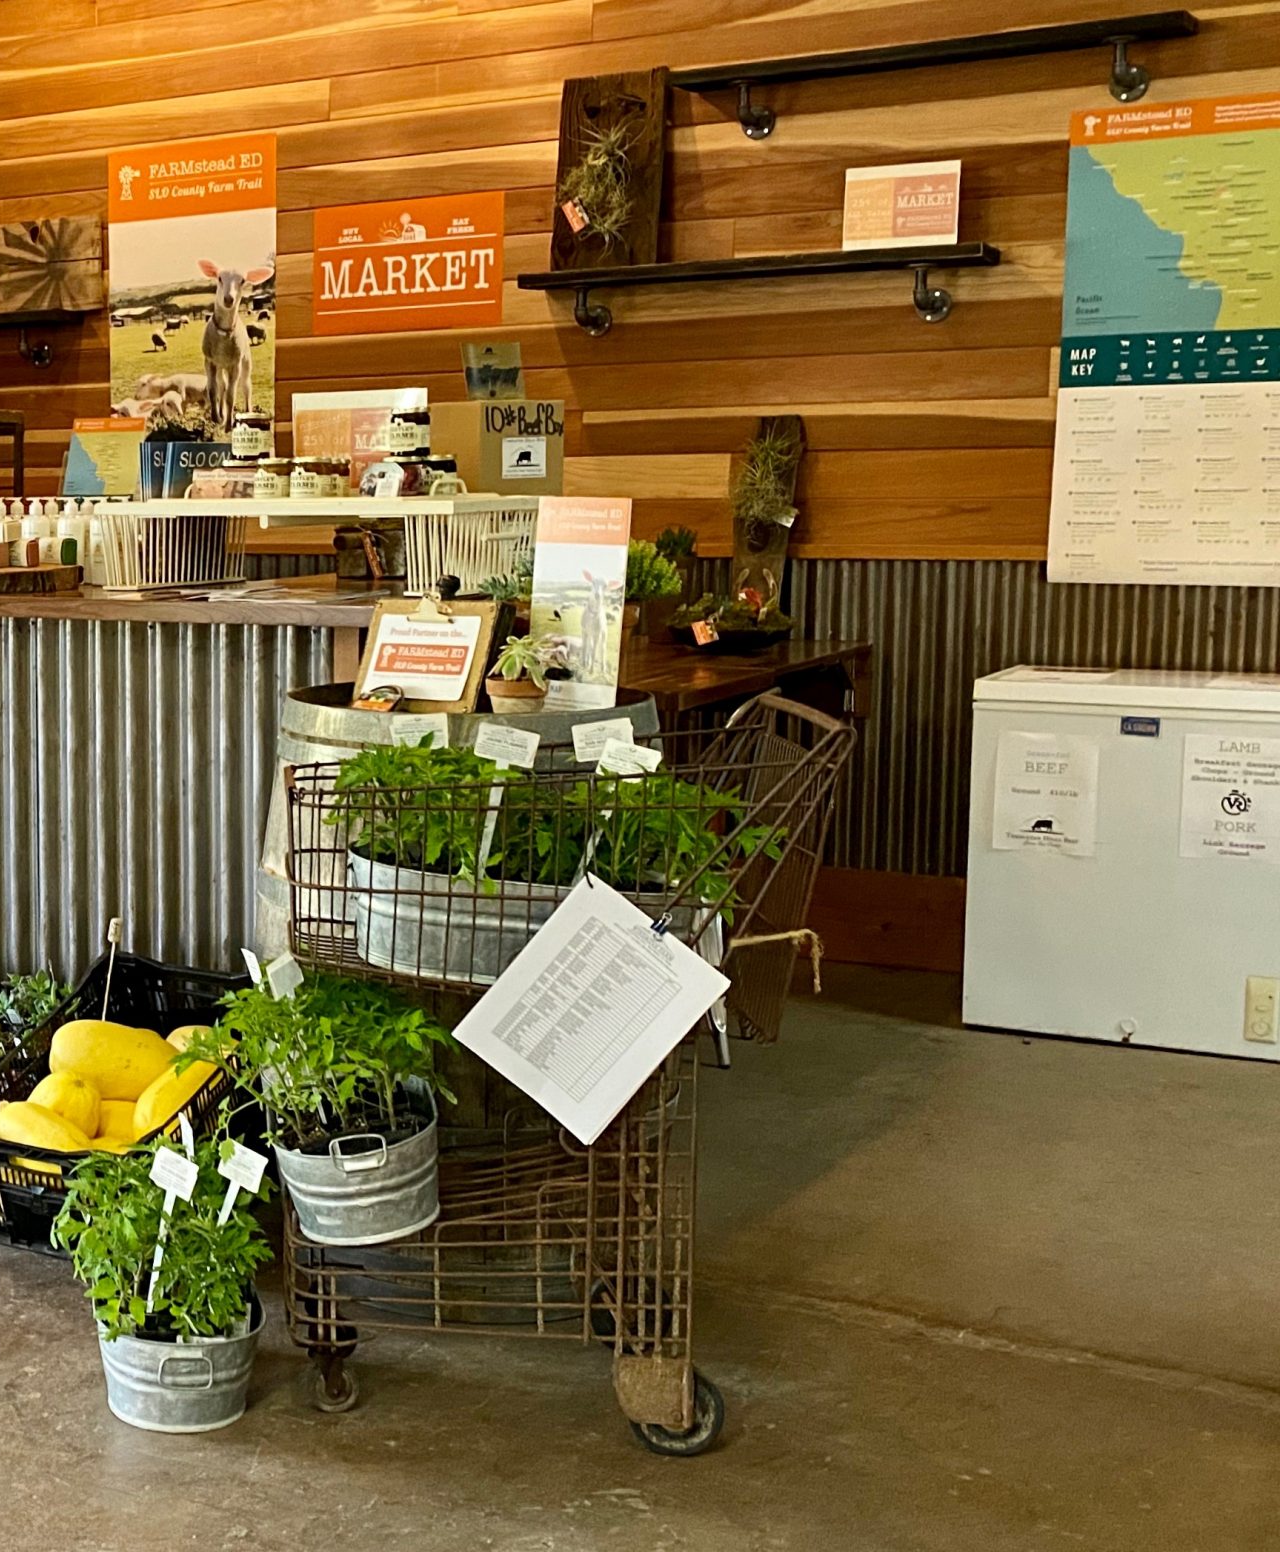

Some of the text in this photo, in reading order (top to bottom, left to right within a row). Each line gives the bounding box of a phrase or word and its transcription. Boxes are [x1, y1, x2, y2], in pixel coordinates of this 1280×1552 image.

[148, 152, 263, 179] FARMstead ED
[171, 185, 205, 198] County
[208, 181, 234, 193] Farm
[237, 178, 262, 190] Trail
[896, 191, 954, 208] MARKET
[338, 234, 363, 244] LOCAL
[320, 248, 494, 300] MARKET
[1070, 348, 1096, 361] MAP
[1071, 364, 1094, 376] KEY
[517, 403, 545, 436] Beef
[153, 451, 166, 467] SL
[179, 451, 206, 468] SLO
[397, 646, 449, 657] FARMstead
[1219, 740, 1261, 753] LAMB
[1024, 760, 1069, 775] BEEF
[1194, 758, 1241, 767] Breakfast
[1214, 820, 1257, 833] PORK
